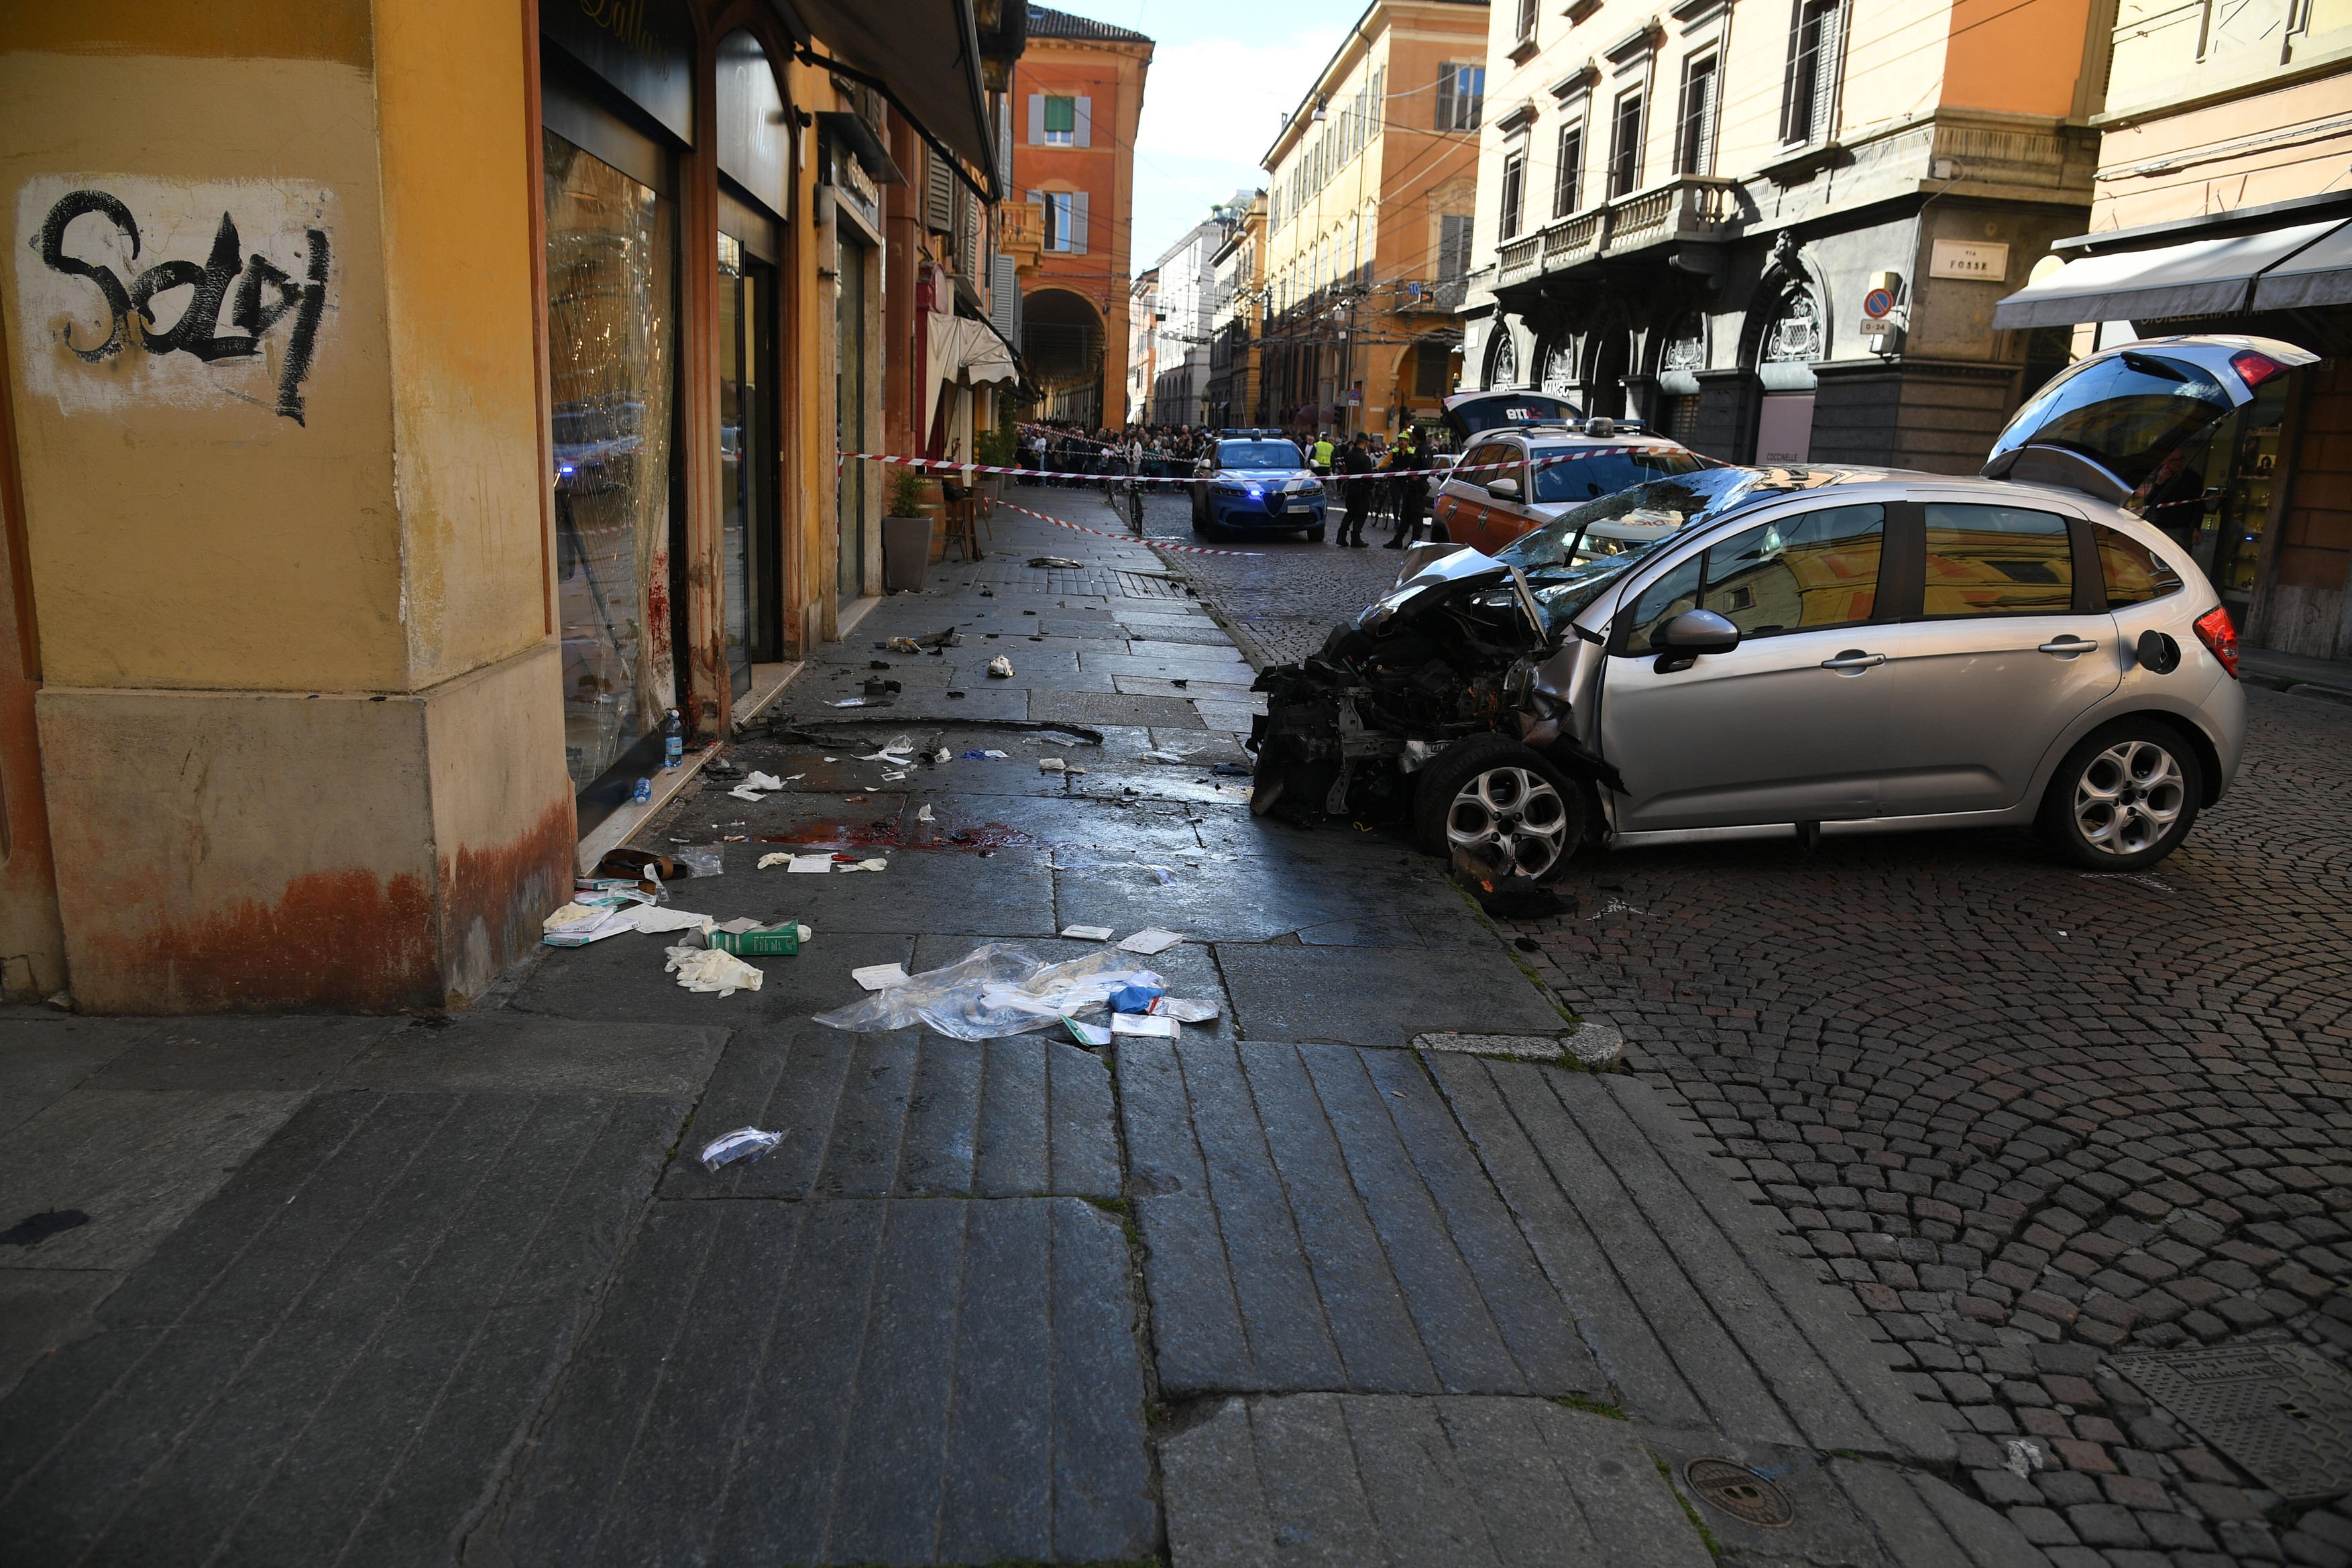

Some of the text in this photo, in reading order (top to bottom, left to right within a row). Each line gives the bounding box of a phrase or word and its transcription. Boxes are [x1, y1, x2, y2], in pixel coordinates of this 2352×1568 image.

[1950, 260, 1988, 270] FOSSE
[1410, 284, 1419, 295] 10
[1767, 453, 1798, 461] COCCINELLE
